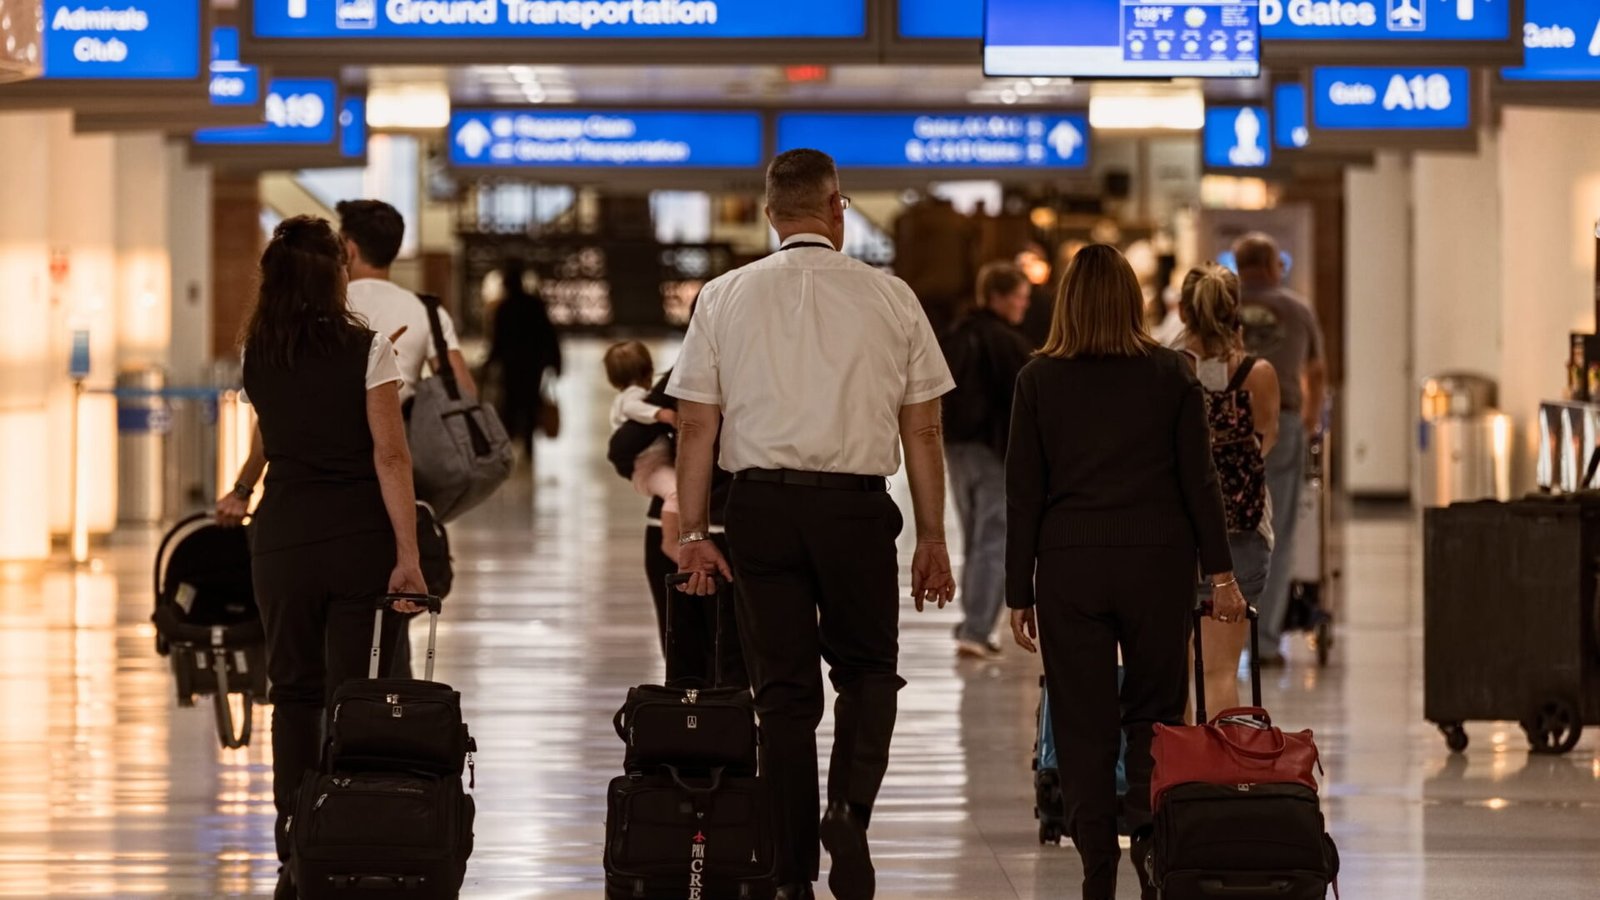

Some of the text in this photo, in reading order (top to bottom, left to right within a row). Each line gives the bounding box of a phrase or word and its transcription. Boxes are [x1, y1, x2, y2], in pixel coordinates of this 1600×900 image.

[51, 6, 149, 31] Admirals
[385, 0, 718, 30] Ground Transportation
[1258, 0, 1283, 25] D
[1287, 0, 1377, 26] Gates
[73, 36, 128, 62] Club
[1382, 73, 1451, 110] A18
